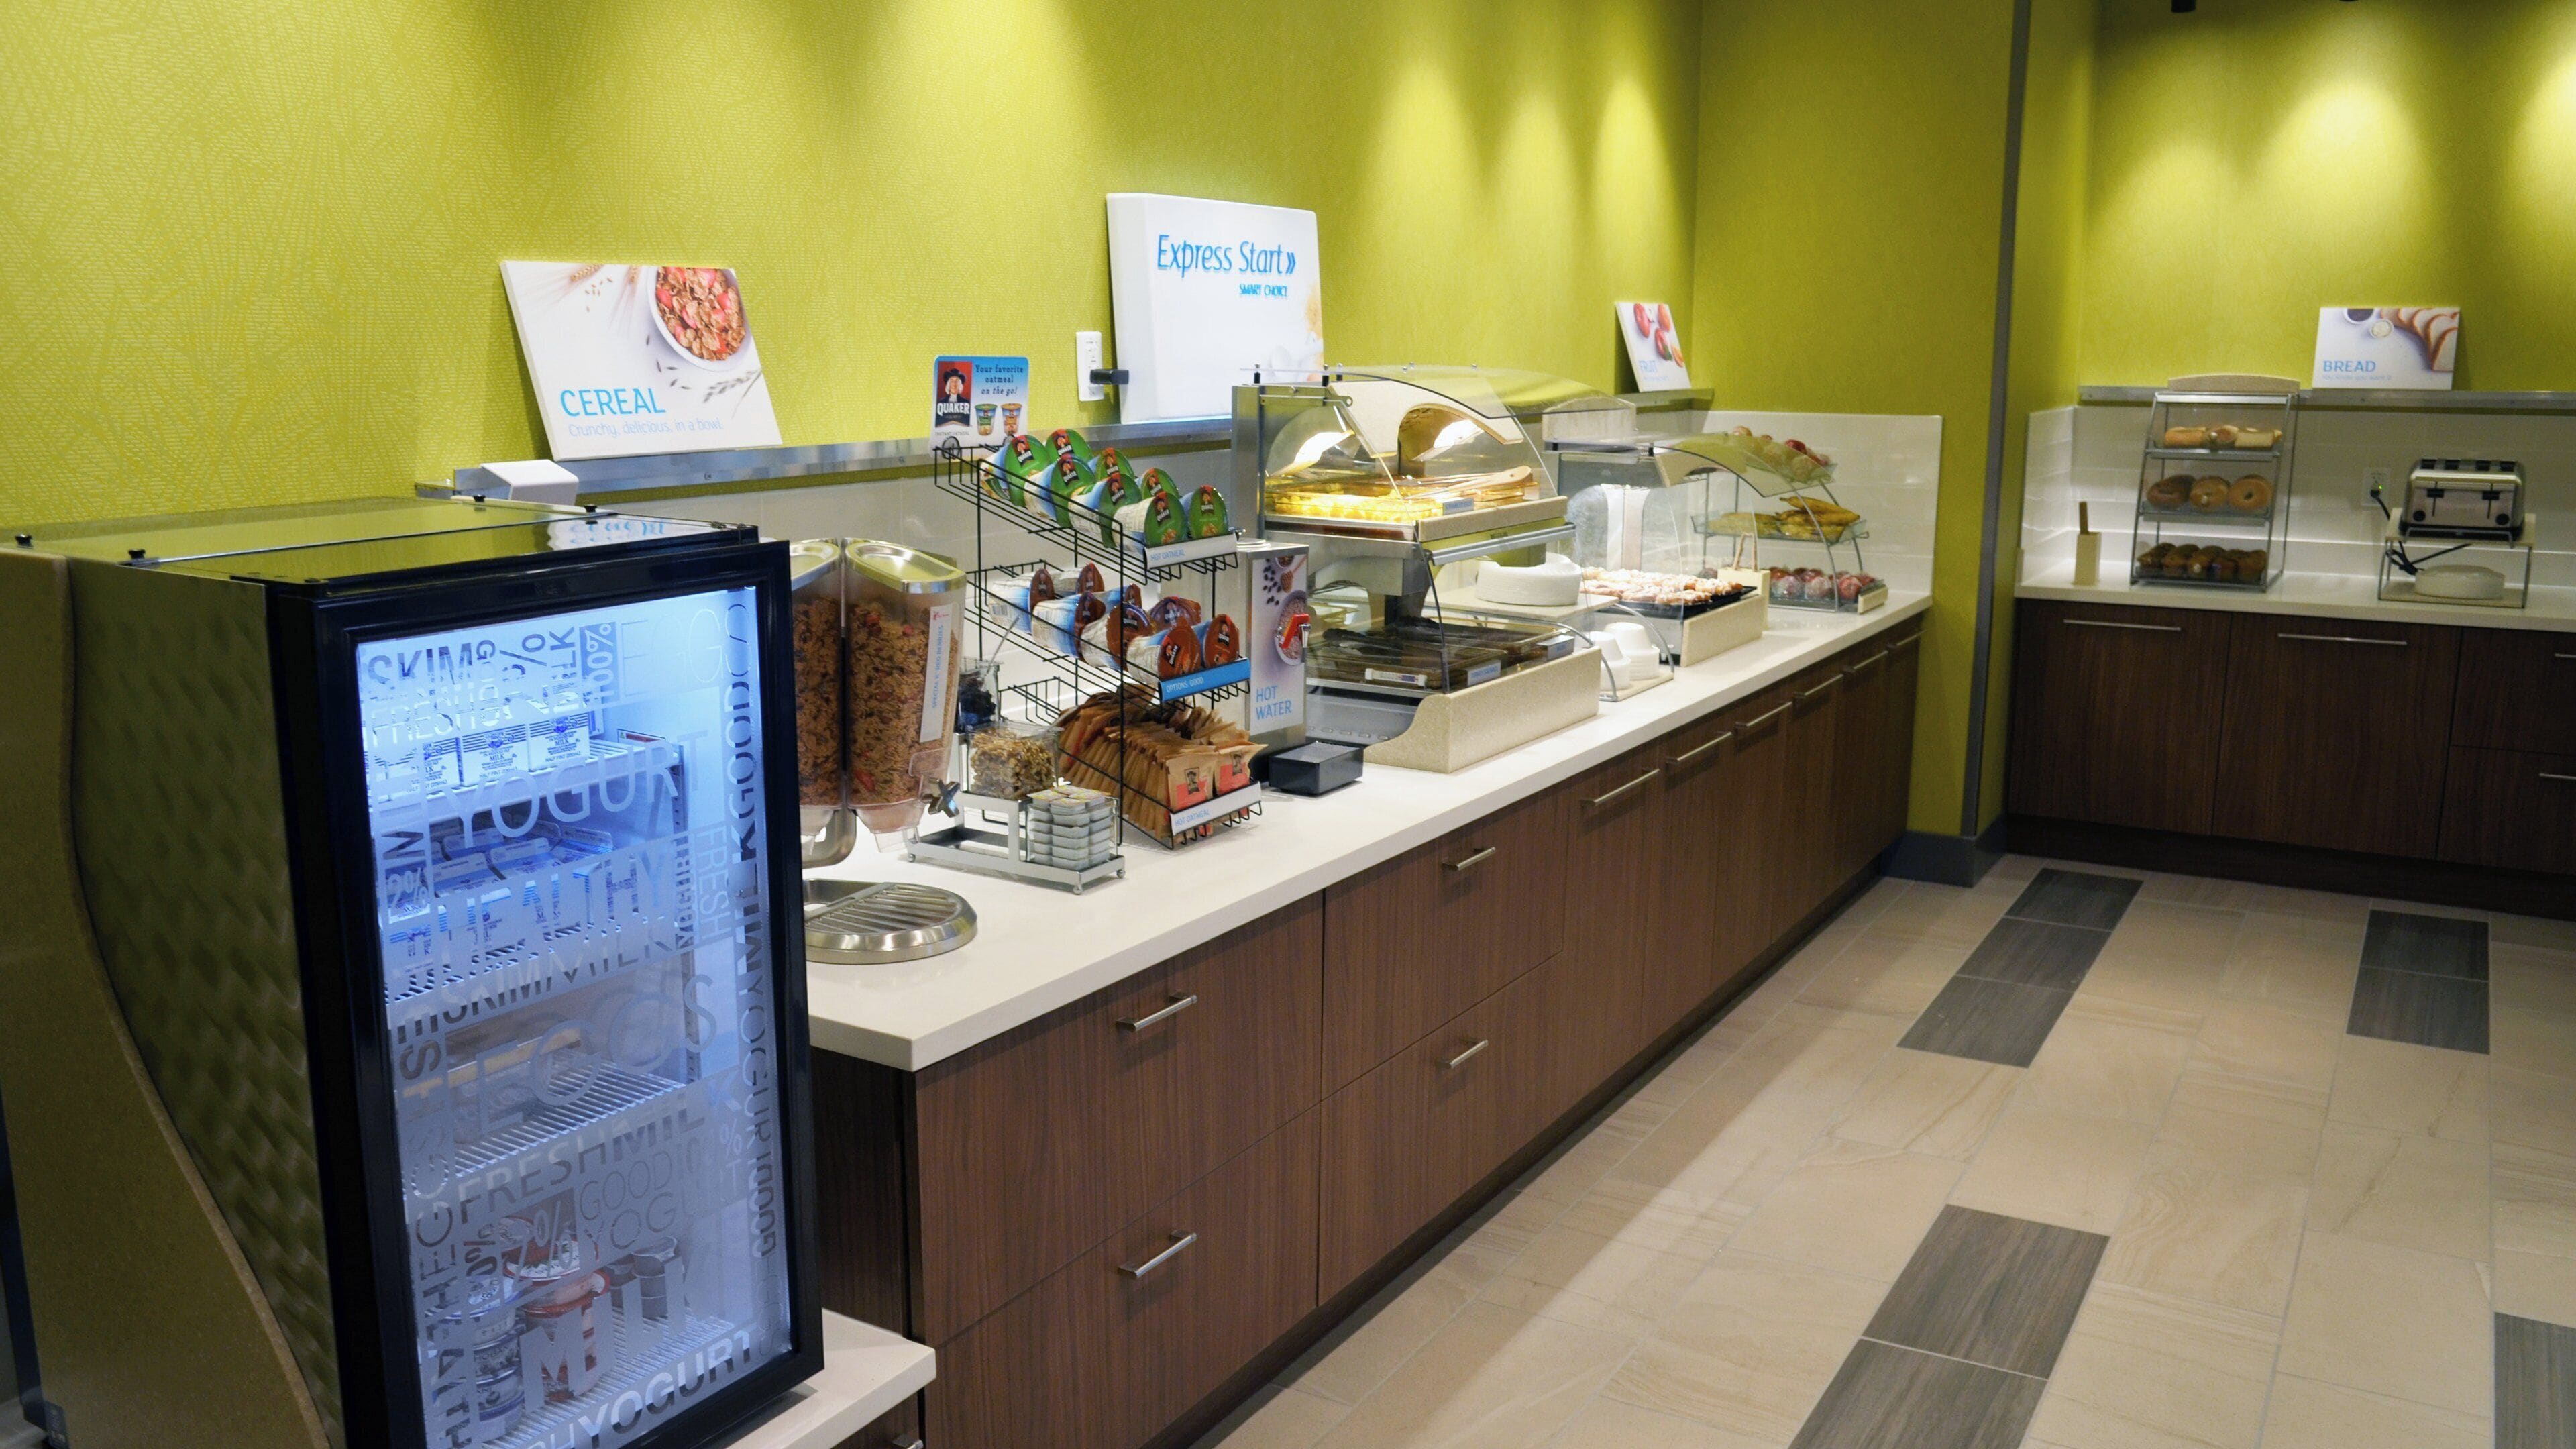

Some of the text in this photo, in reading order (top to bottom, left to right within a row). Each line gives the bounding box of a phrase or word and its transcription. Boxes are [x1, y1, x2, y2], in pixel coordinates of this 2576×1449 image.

[1157, 234, 1232, 278] Express
[1239, 284, 1288, 297] SMART CHOICE
[975, 364, 1024, 374] Your favorite
[2322, 360, 2377, 372] BREAD
[985, 374, 1014, 384] oatmeal
[992, 386, 1004, 395] the
[1005, 386, 1018, 397] go!
[559, 387, 667, 417] CEREAL
[936, 402, 971, 416] QUAKER
[675, 419, 686, 431] in
[688, 421, 696, 431] a
[1150, 553, 1161, 561] HOT
[931, 680, 941, 709] SPECIAL
[1165, 680, 1188, 693] OPTIONS
[1254, 685, 1279, 704] HOT
[1254, 701, 1293, 722] WATER
[489, 753, 505, 761] MILK
[443, 729, 709, 849] YOGURT
[1174, 817, 1185, 828] HOT
[695, 825, 734, 939] FRESH
[437, 847, 669, 970] HEALTHY
[737, 975, 772, 1165] YOGURT
[458, 1128, 608, 1224] FRESH
[579, 1150, 672, 1221] GOOD
[748, 1165, 777, 1258] GOOD
[578, 1322, 757, 1449] YOGURT
